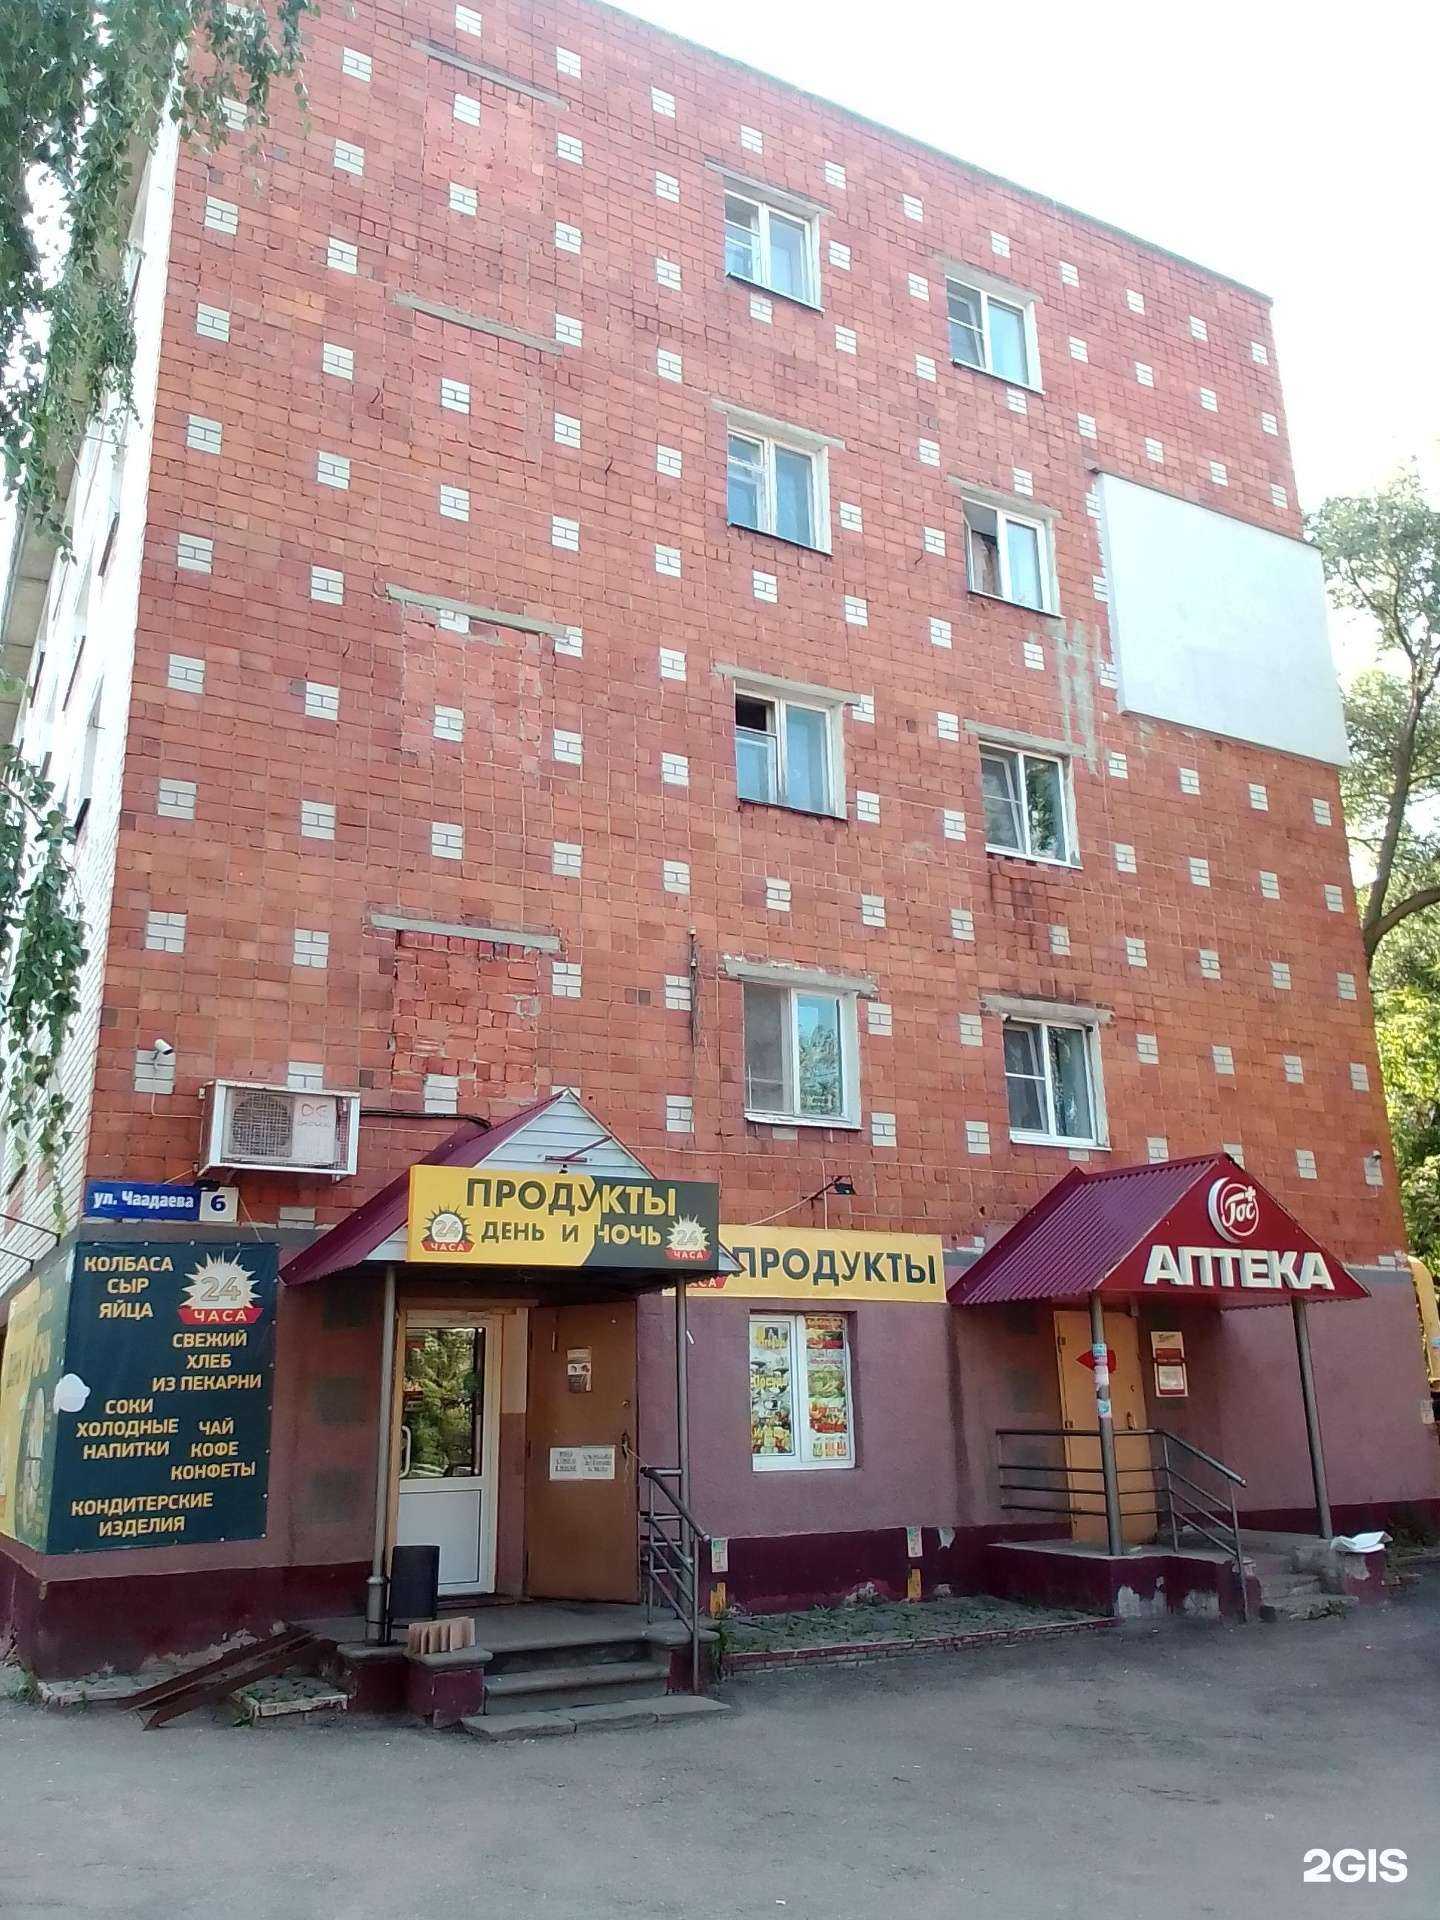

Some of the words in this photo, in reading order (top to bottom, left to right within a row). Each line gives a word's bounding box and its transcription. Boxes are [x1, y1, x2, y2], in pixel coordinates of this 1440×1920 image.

[93, 1191, 118, 1209] ул.
[121, 1190, 194, 1209] Чаадаева
[210, 1194, 227, 1212] 6
[466, 1177, 677, 1216] ПРОДУКТЫ
[434, 1219, 461, 1238] 24
[481, 1220, 545, 1243] ДЕНЬ
[561, 1223, 579, 1243] И
[593, 1223, 662, 1246] НОЧЬ
[430, 1242, 465, 1251] ЧАСА
[673, 1250, 704, 1260] ЧАСА
[84, 1255, 175, 1273] КОЛБАСА
[733, 1246, 937, 1286] ПРОДУКТЫ
[1143, 1244, 1336, 1291] АПТЕКА
[106, 1277, 150, 1295] СЫР
[199, 1276, 243, 1302] 24
[98, 1301, 154, 1320] ЯЙЦА
[194, 1309, 249, 1323] ЧАСА
[172, 1330, 248, 1349] СВЕЖИЙ
[185, 1353, 232, 1369] ХЛЕБ
[152, 1375, 176, 1392] ИЗ
[180, 1374, 263, 1392] ПЕКАРНИ
[104, 1398, 154, 1416] СОКИ
[76, 1418, 180, 1438] ХОЛОДНЫЕ
[198, 1416, 235, 1435] ЧАЙ
[82, 1442, 170, 1460] НАПИТКИ
[189, 1441, 239, 1458] КОФЕ
[170, 1462, 257, 1481] КОНФЕТЫ
[70, 1492, 214, 1518] КОНДИТЕРСКИЕ
[98, 1515, 186, 1538] ИЗДЕЛИЯ
